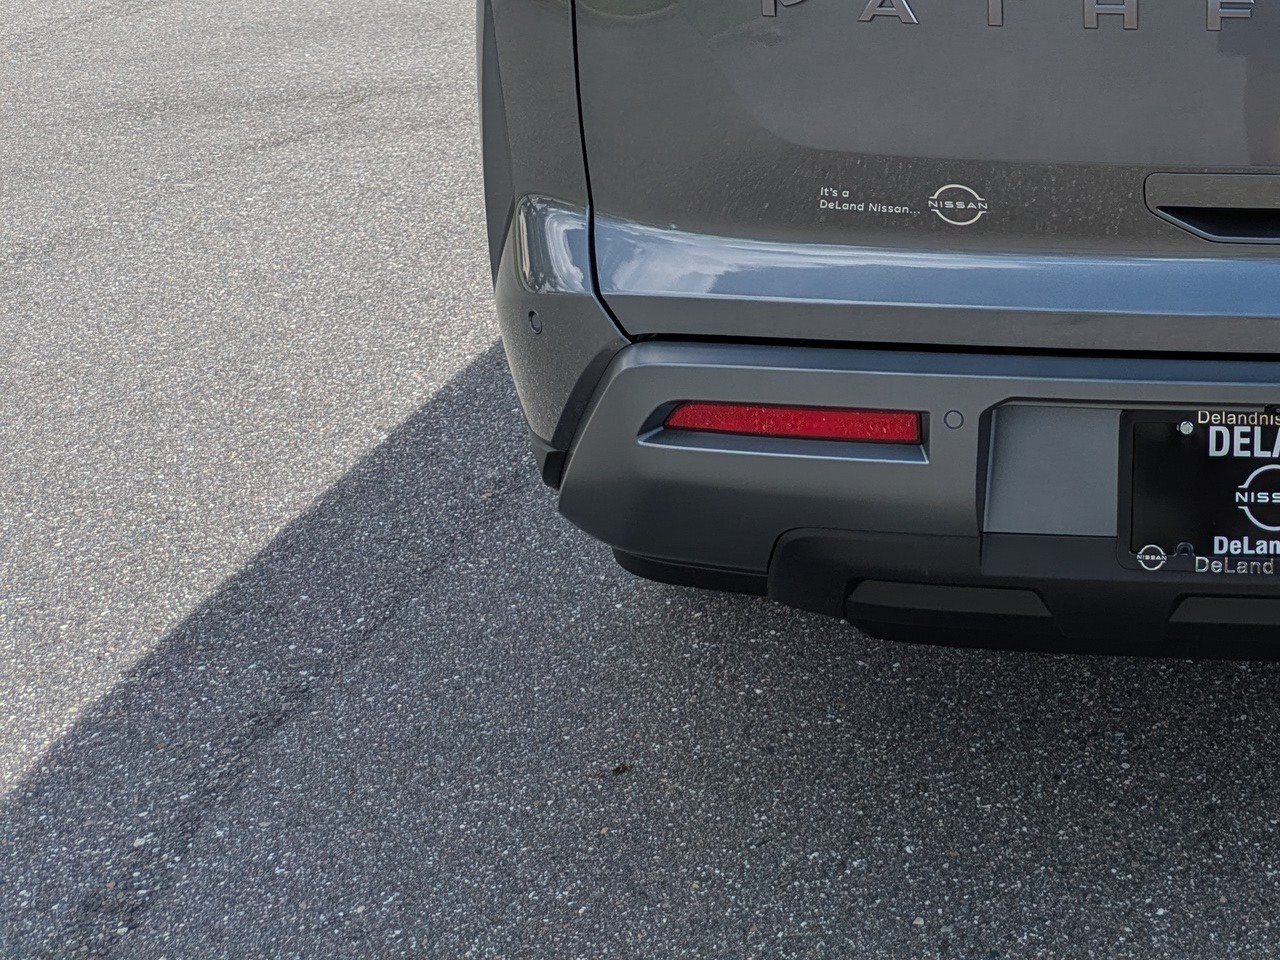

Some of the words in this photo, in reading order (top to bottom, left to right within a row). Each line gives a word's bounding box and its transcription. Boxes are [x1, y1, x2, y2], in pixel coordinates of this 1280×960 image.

[820, 186, 838, 197] It's
[841, 190, 850, 198] a
[819, 199, 865, 211] DeLand
[928, 200, 988, 210] NISSAN
[1194, 556, 1274, 576] DeLand
